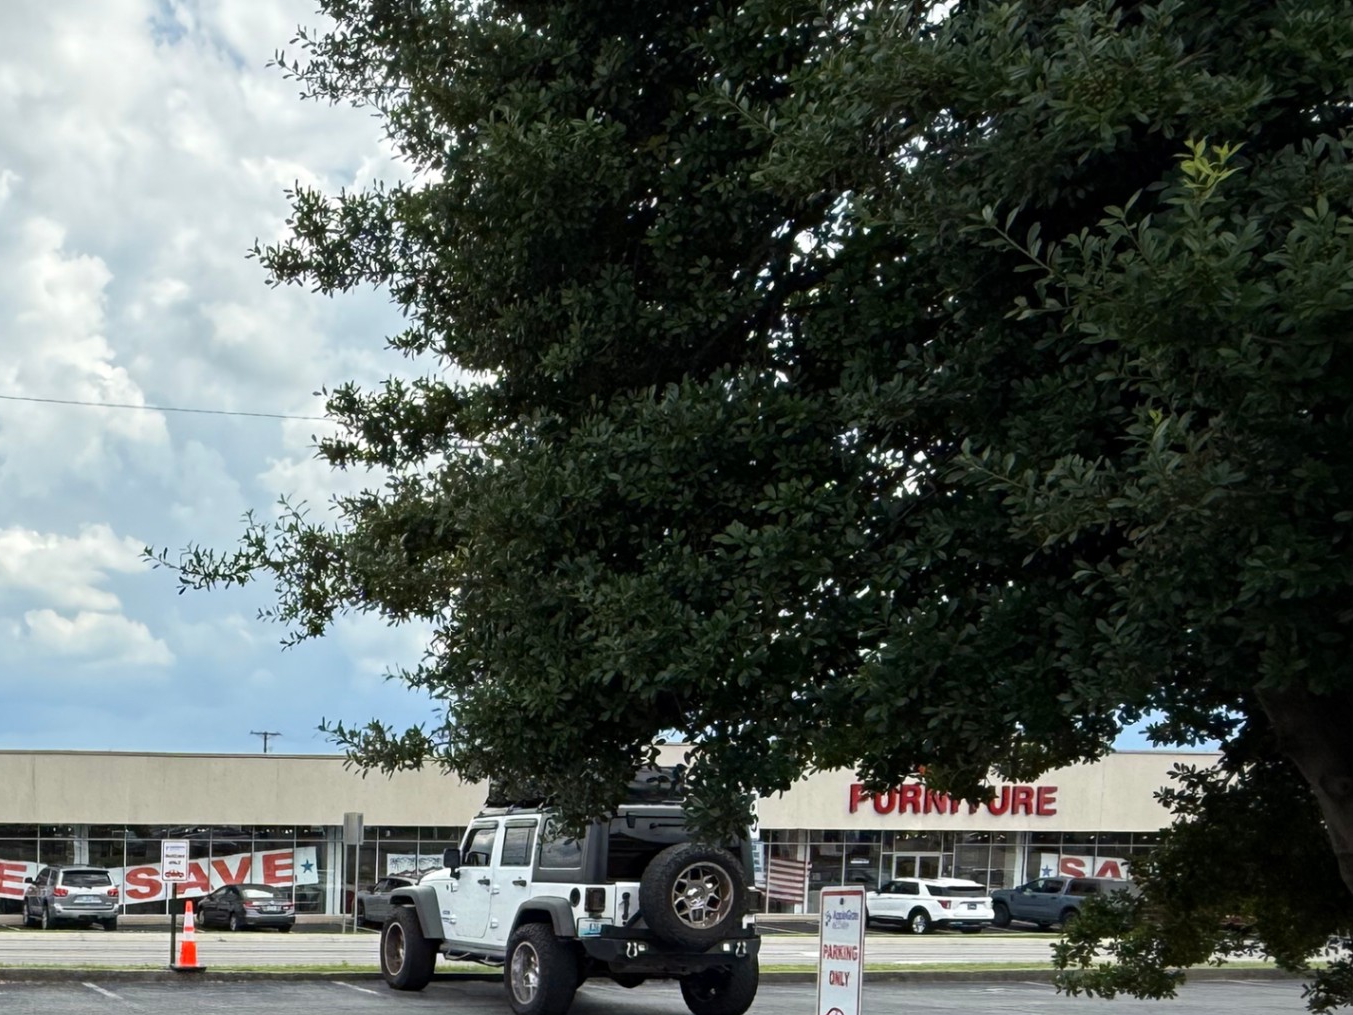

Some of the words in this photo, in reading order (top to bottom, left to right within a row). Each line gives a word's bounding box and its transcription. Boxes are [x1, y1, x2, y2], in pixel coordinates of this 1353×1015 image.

[849, 784, 1058, 817] FURNIURE
[126, 852, 294, 900] SAVE
[822, 944, 859, 961] PARKING
[829, 970, 851, 987] ONLY
